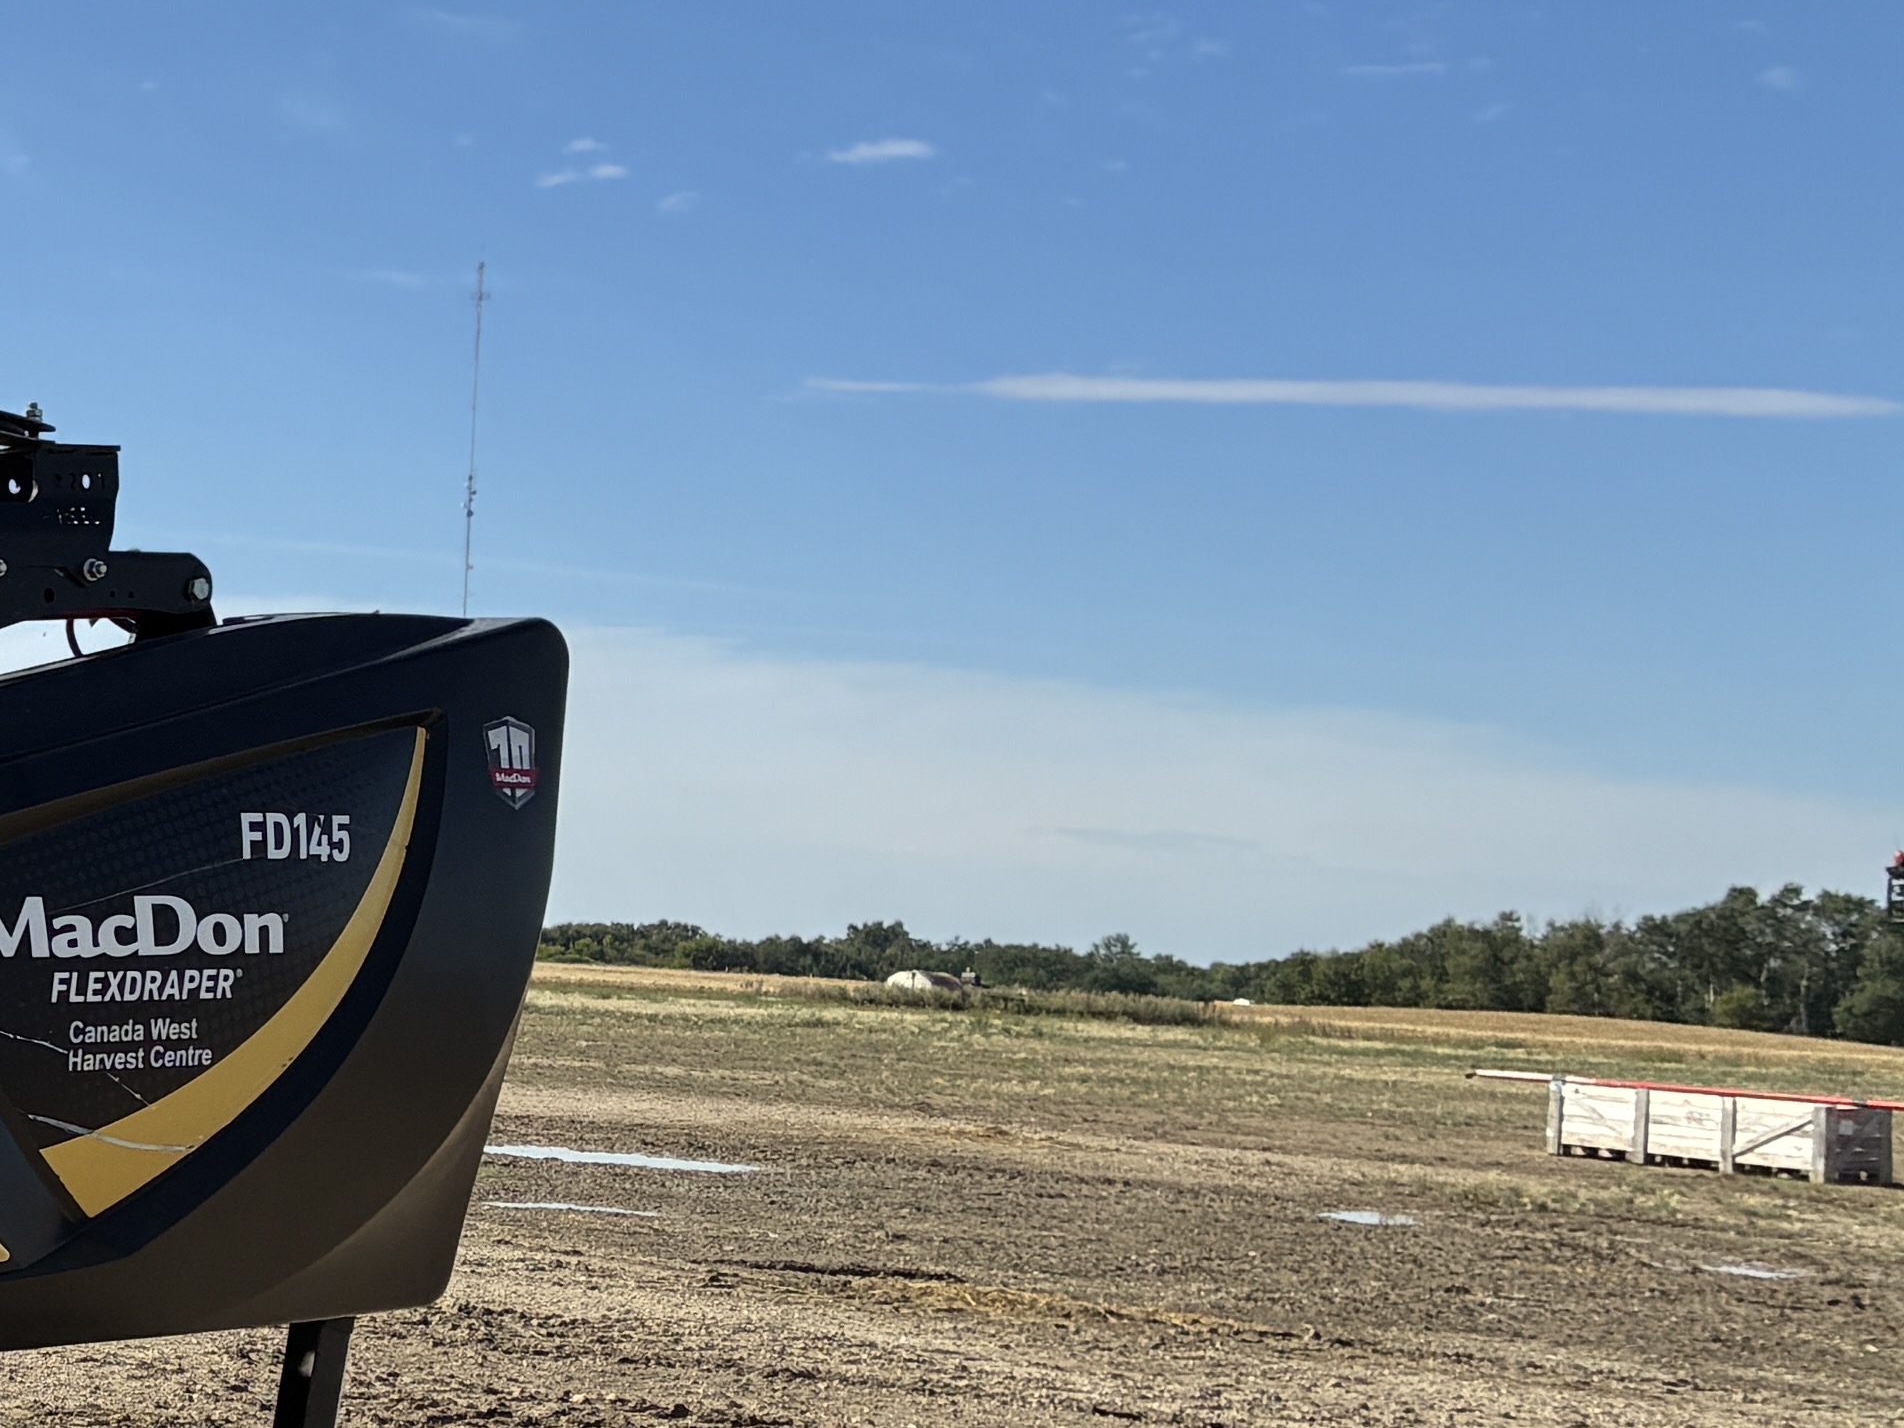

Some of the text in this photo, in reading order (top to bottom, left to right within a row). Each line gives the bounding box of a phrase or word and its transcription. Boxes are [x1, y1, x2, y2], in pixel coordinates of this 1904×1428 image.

[240, 812, 351, 863] FD145
[51, 968, 235, 1003] FLEXDRAPER
[69, 1017, 198, 1044] Canada West
[68, 1046, 213, 1072] Harvest Centre
